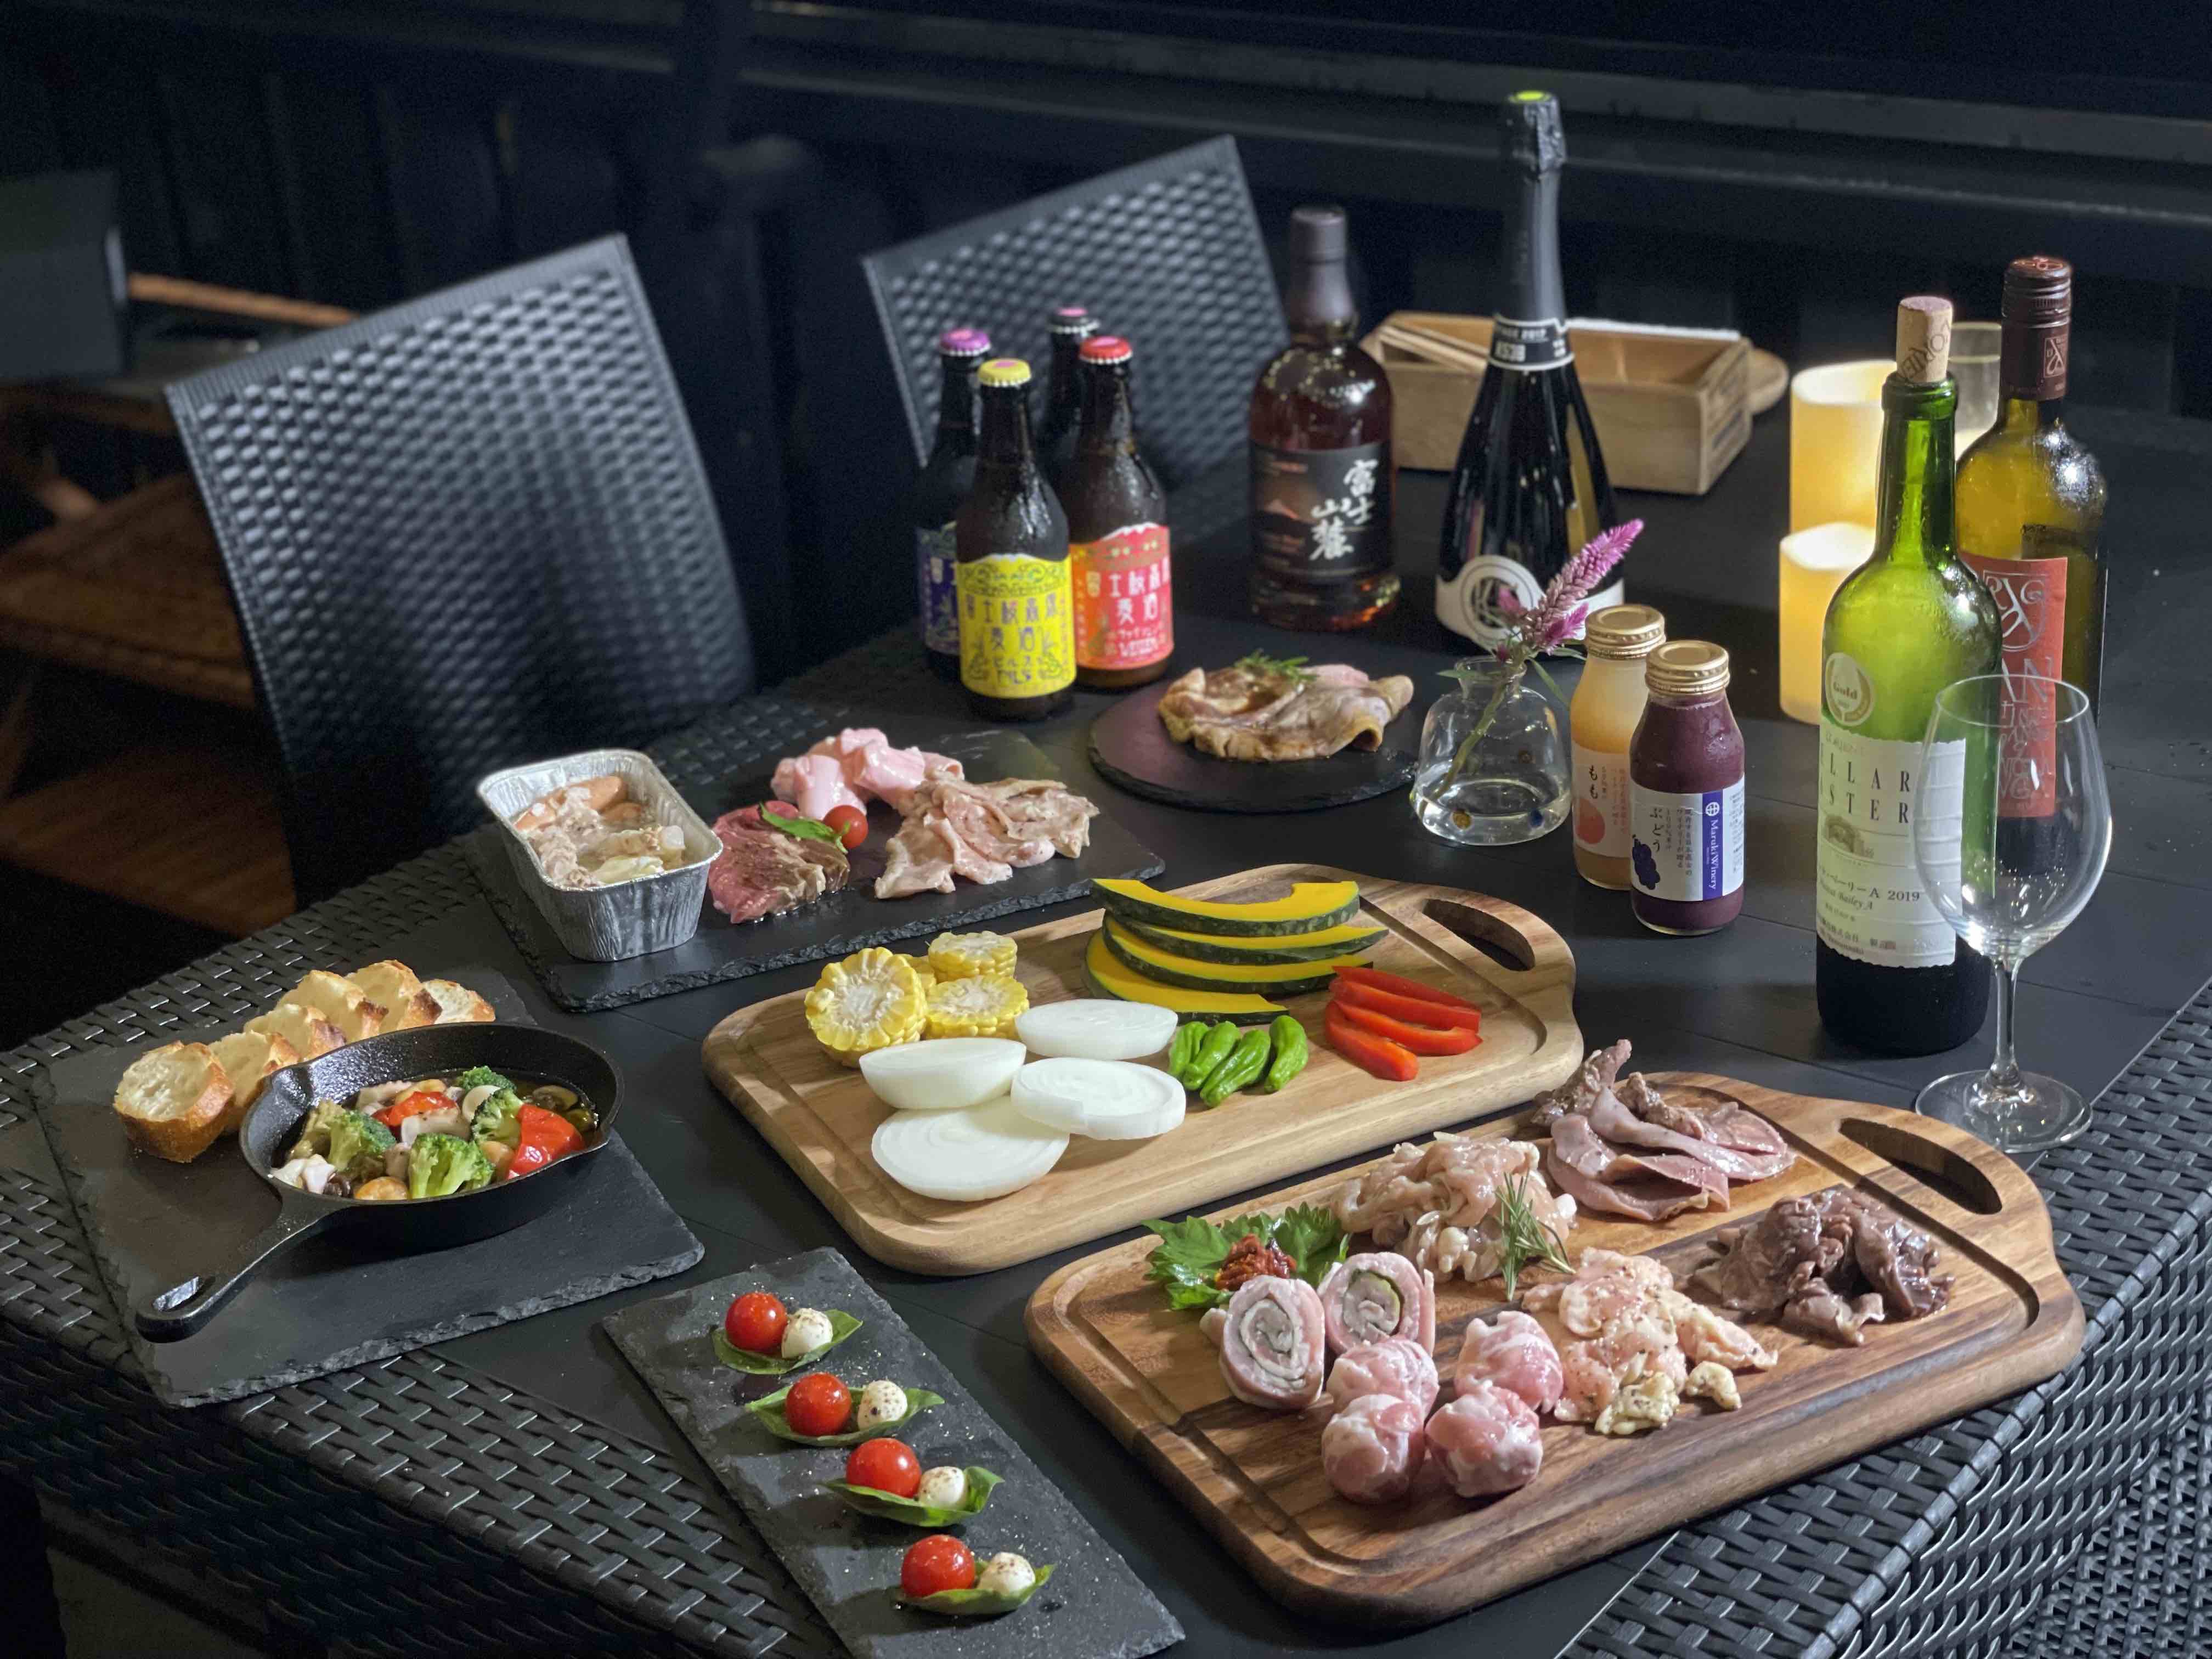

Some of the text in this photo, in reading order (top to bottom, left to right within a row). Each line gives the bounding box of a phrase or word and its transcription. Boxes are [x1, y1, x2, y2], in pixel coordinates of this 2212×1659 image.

[1650, 808, 1664, 852] ぶどう
[1886, 889, 1921, 902] 2019
